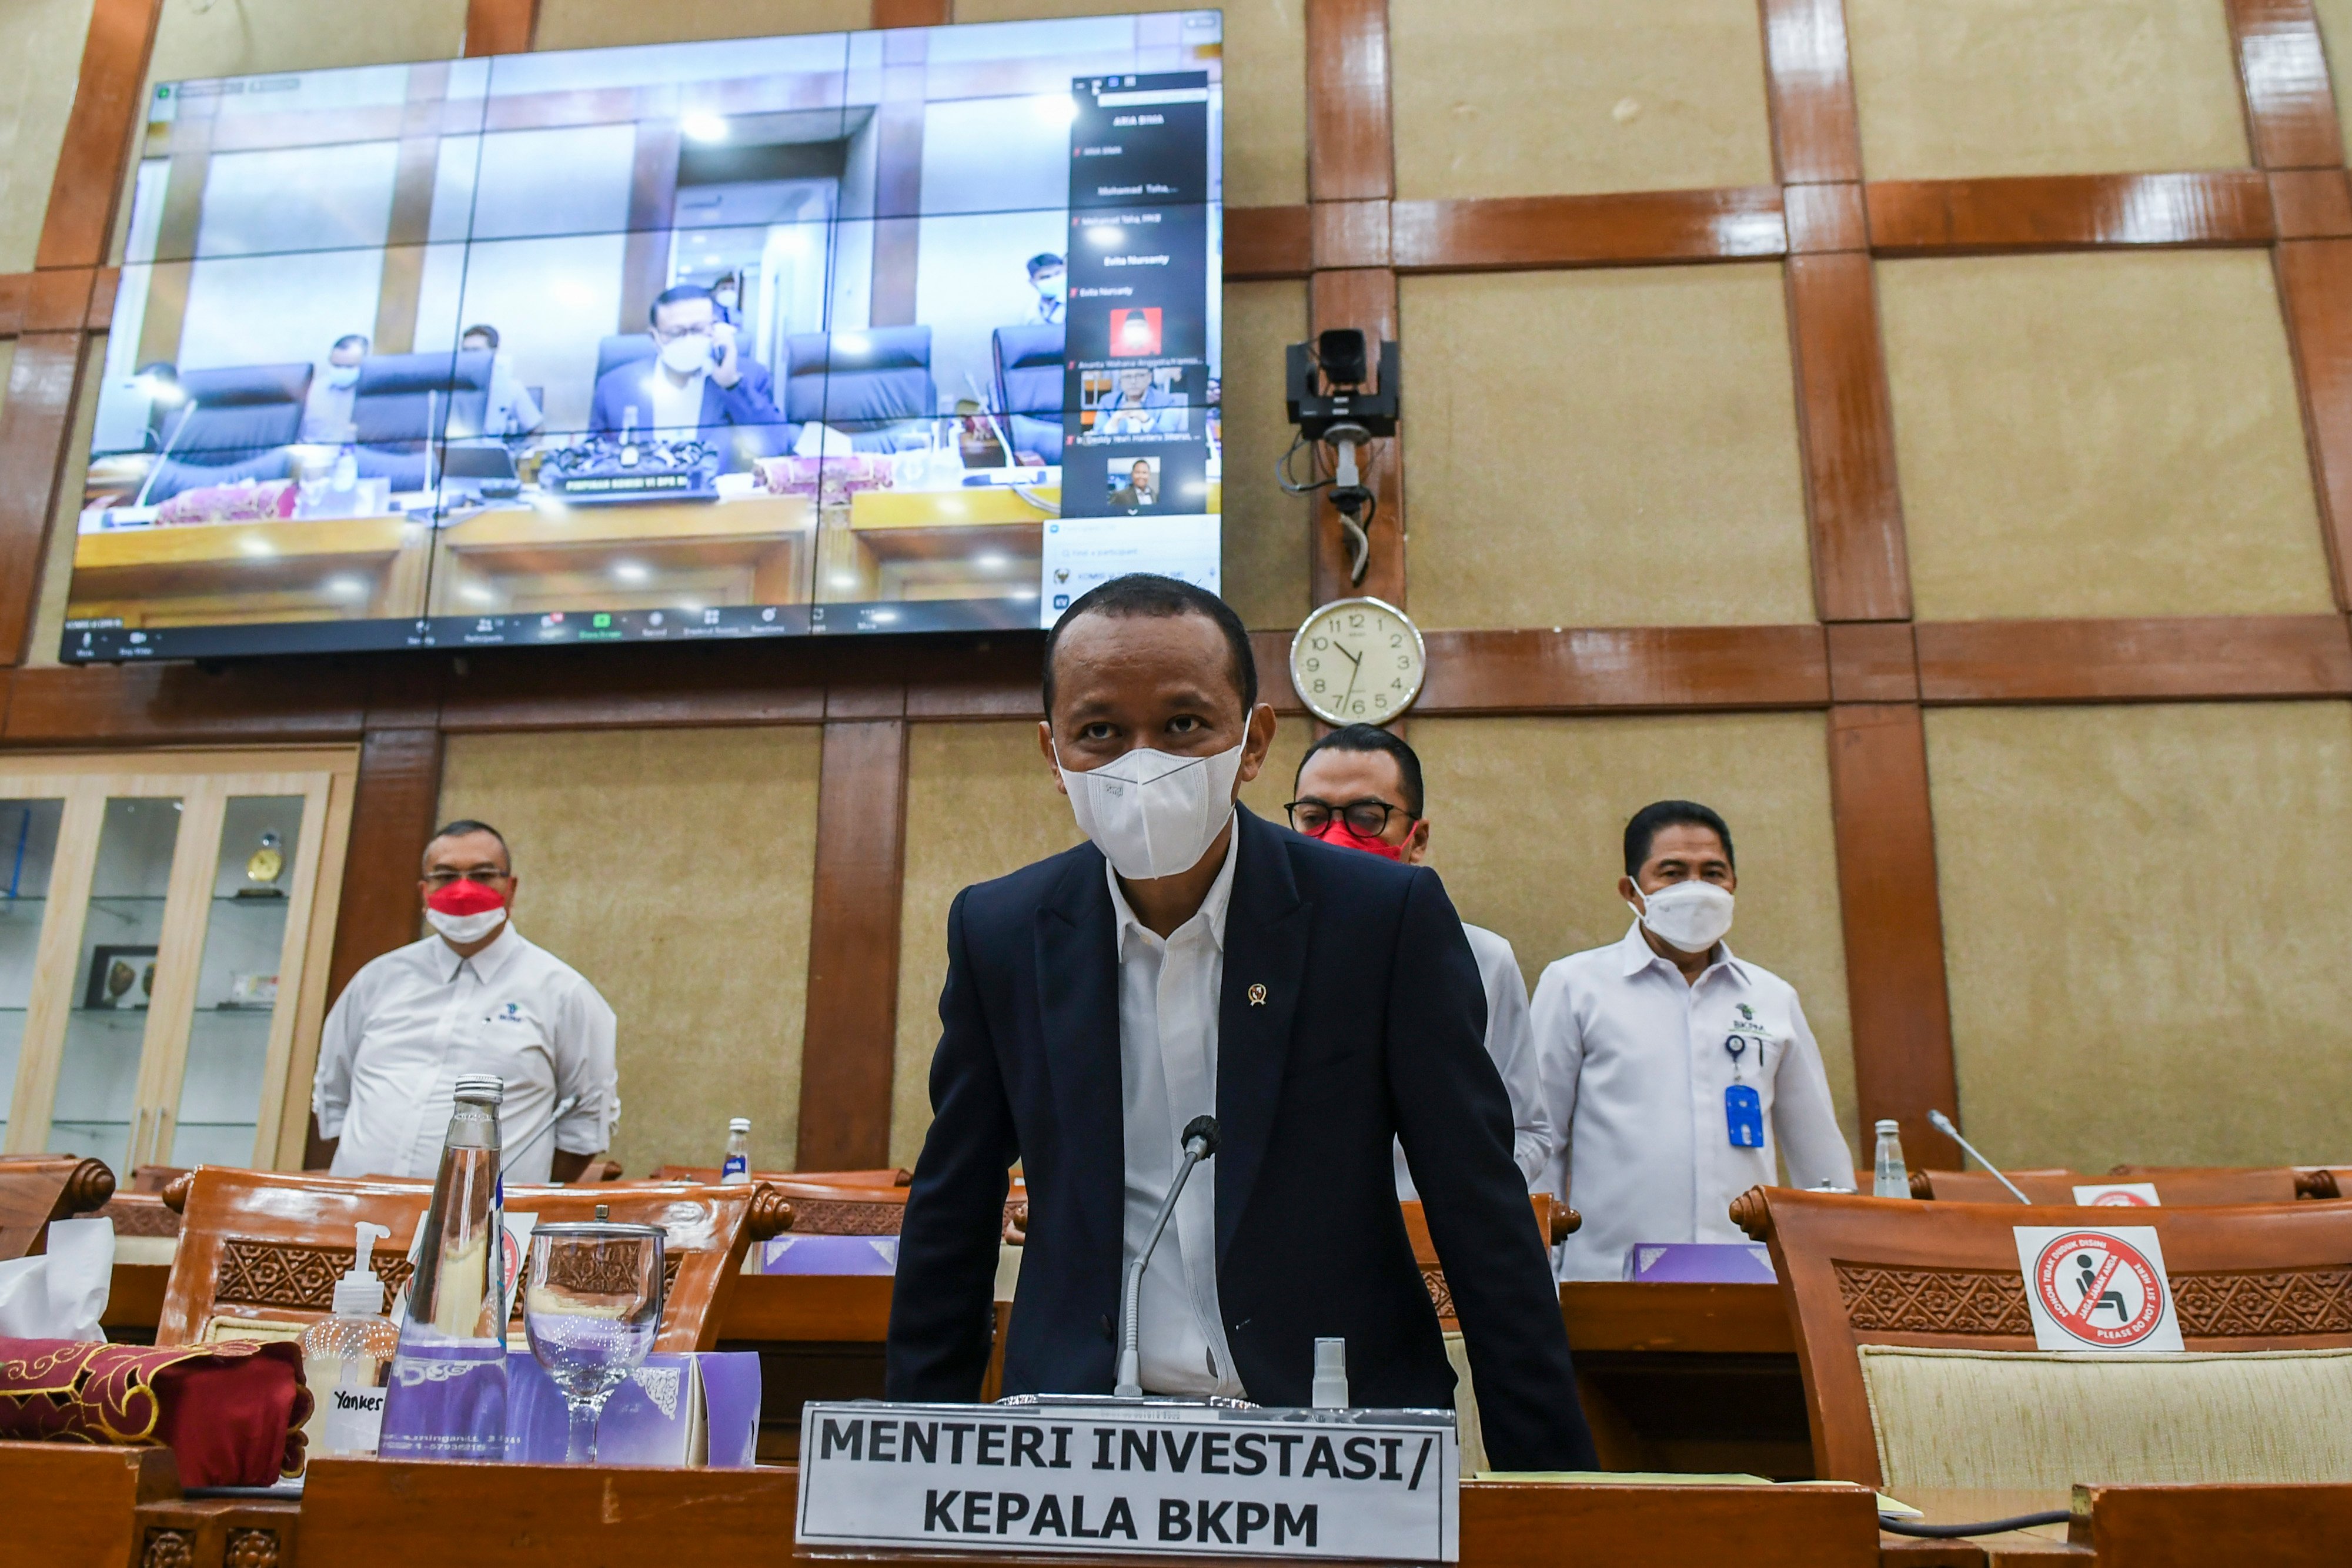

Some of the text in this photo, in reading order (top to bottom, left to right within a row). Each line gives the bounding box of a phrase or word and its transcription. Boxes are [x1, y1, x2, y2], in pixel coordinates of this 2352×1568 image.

[1329, 619, 1341, 633] 11
[1349, 614, 1365, 627] 12
[1377, 620, 1382, 631] 1
[1312, 637, 1328, 651] 10
[1391, 634, 1402, 648] 2
[1307, 658, 1319, 672] 9
[1398, 656, 1410, 670] 3
[1313, 679, 1326, 693] 8
[1391, 677, 1402, 690] 4
[1332, 695, 1344, 709] 7
[1352, 700, 1365, 714] 6
[1375, 694, 1388, 708] 5
[2051, 1241, 2078, 1259] DUDUK
[2043, 1258, 2056, 1283] TIDAK
[2079, 1255, 2119, 1320] JAGA JARAK ANDA
[2044, 1285, 2069, 1318] MOHON
[2097, 1263, 2156, 1339] PLEASE DO NOT SIT HERE
[821, 1417, 1434, 1491] MENTERI INVESTASI/
[924, 1489, 1319, 1547] KEPALA BKPM
